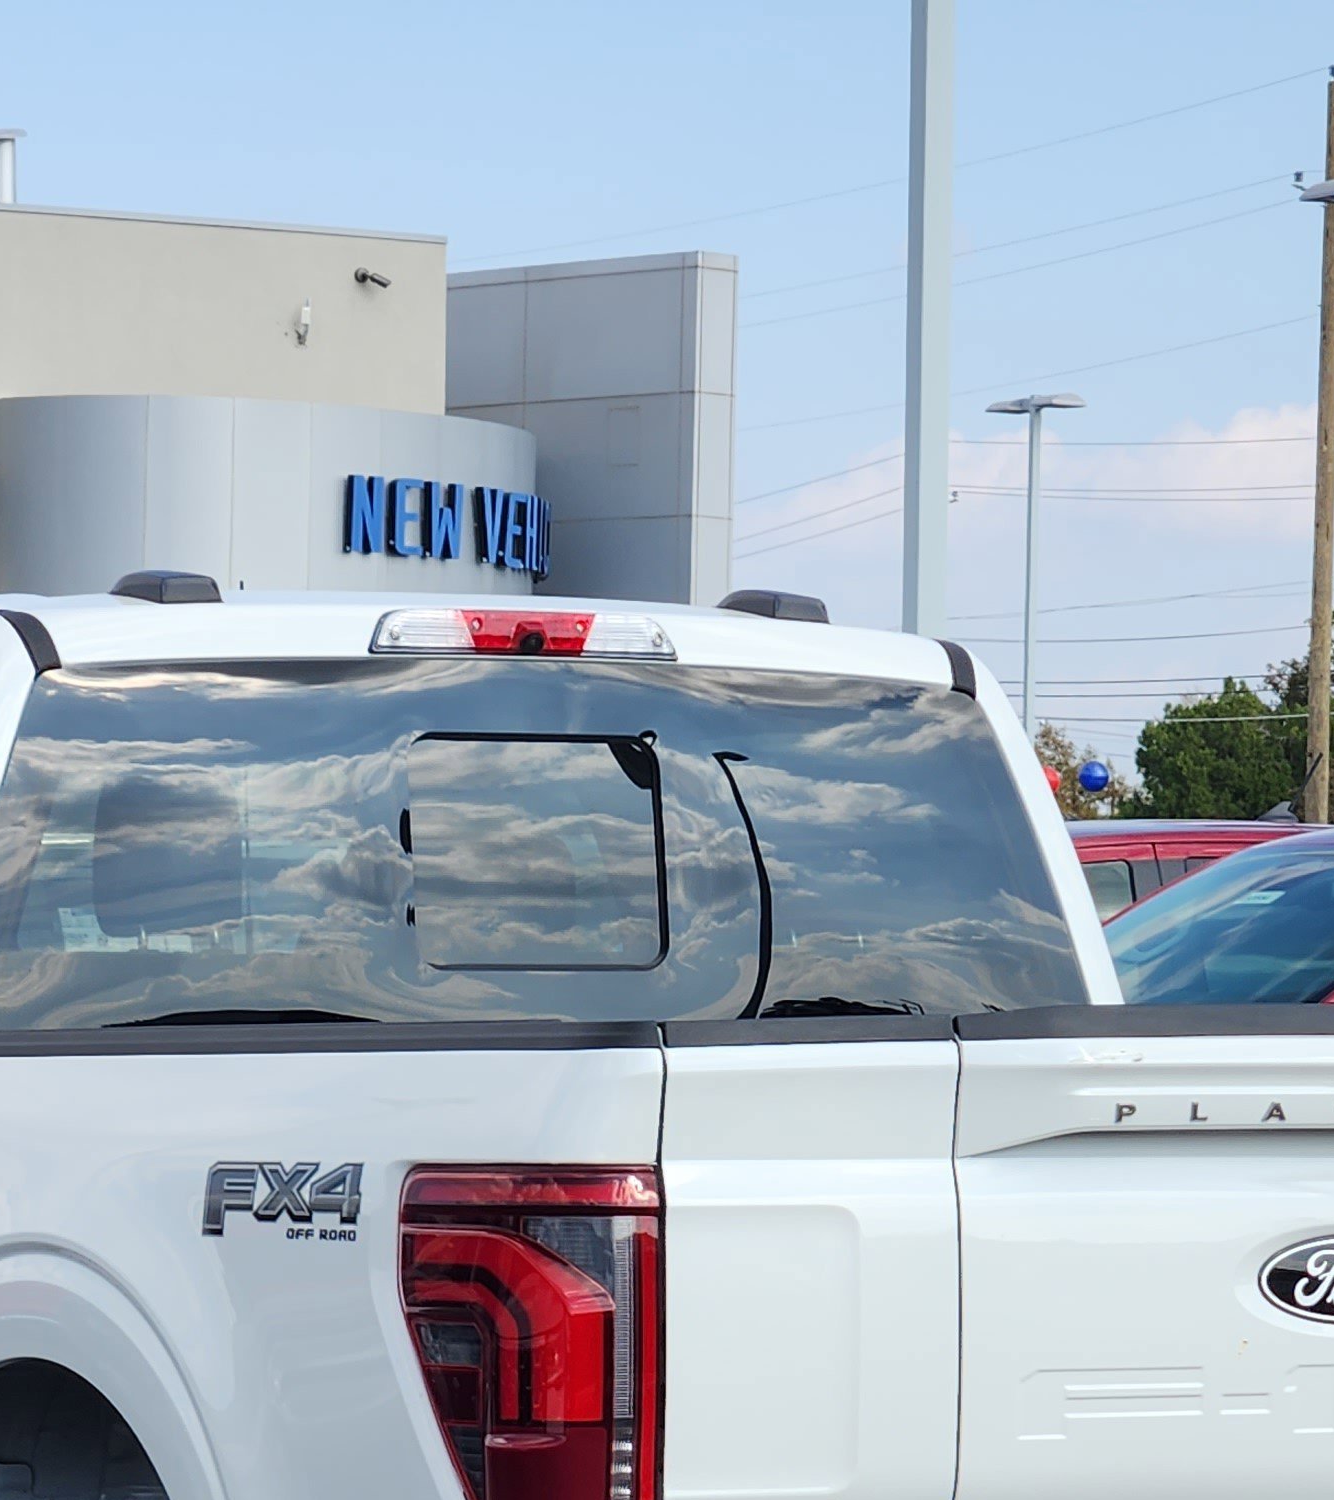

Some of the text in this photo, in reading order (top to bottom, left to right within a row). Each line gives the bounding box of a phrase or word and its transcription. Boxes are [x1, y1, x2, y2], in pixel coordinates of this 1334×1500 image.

[343, 474, 464, 559] NEW
[202, 1161, 365, 1237] FX4
[286, 1228, 357, 1242] OFF ROAD
